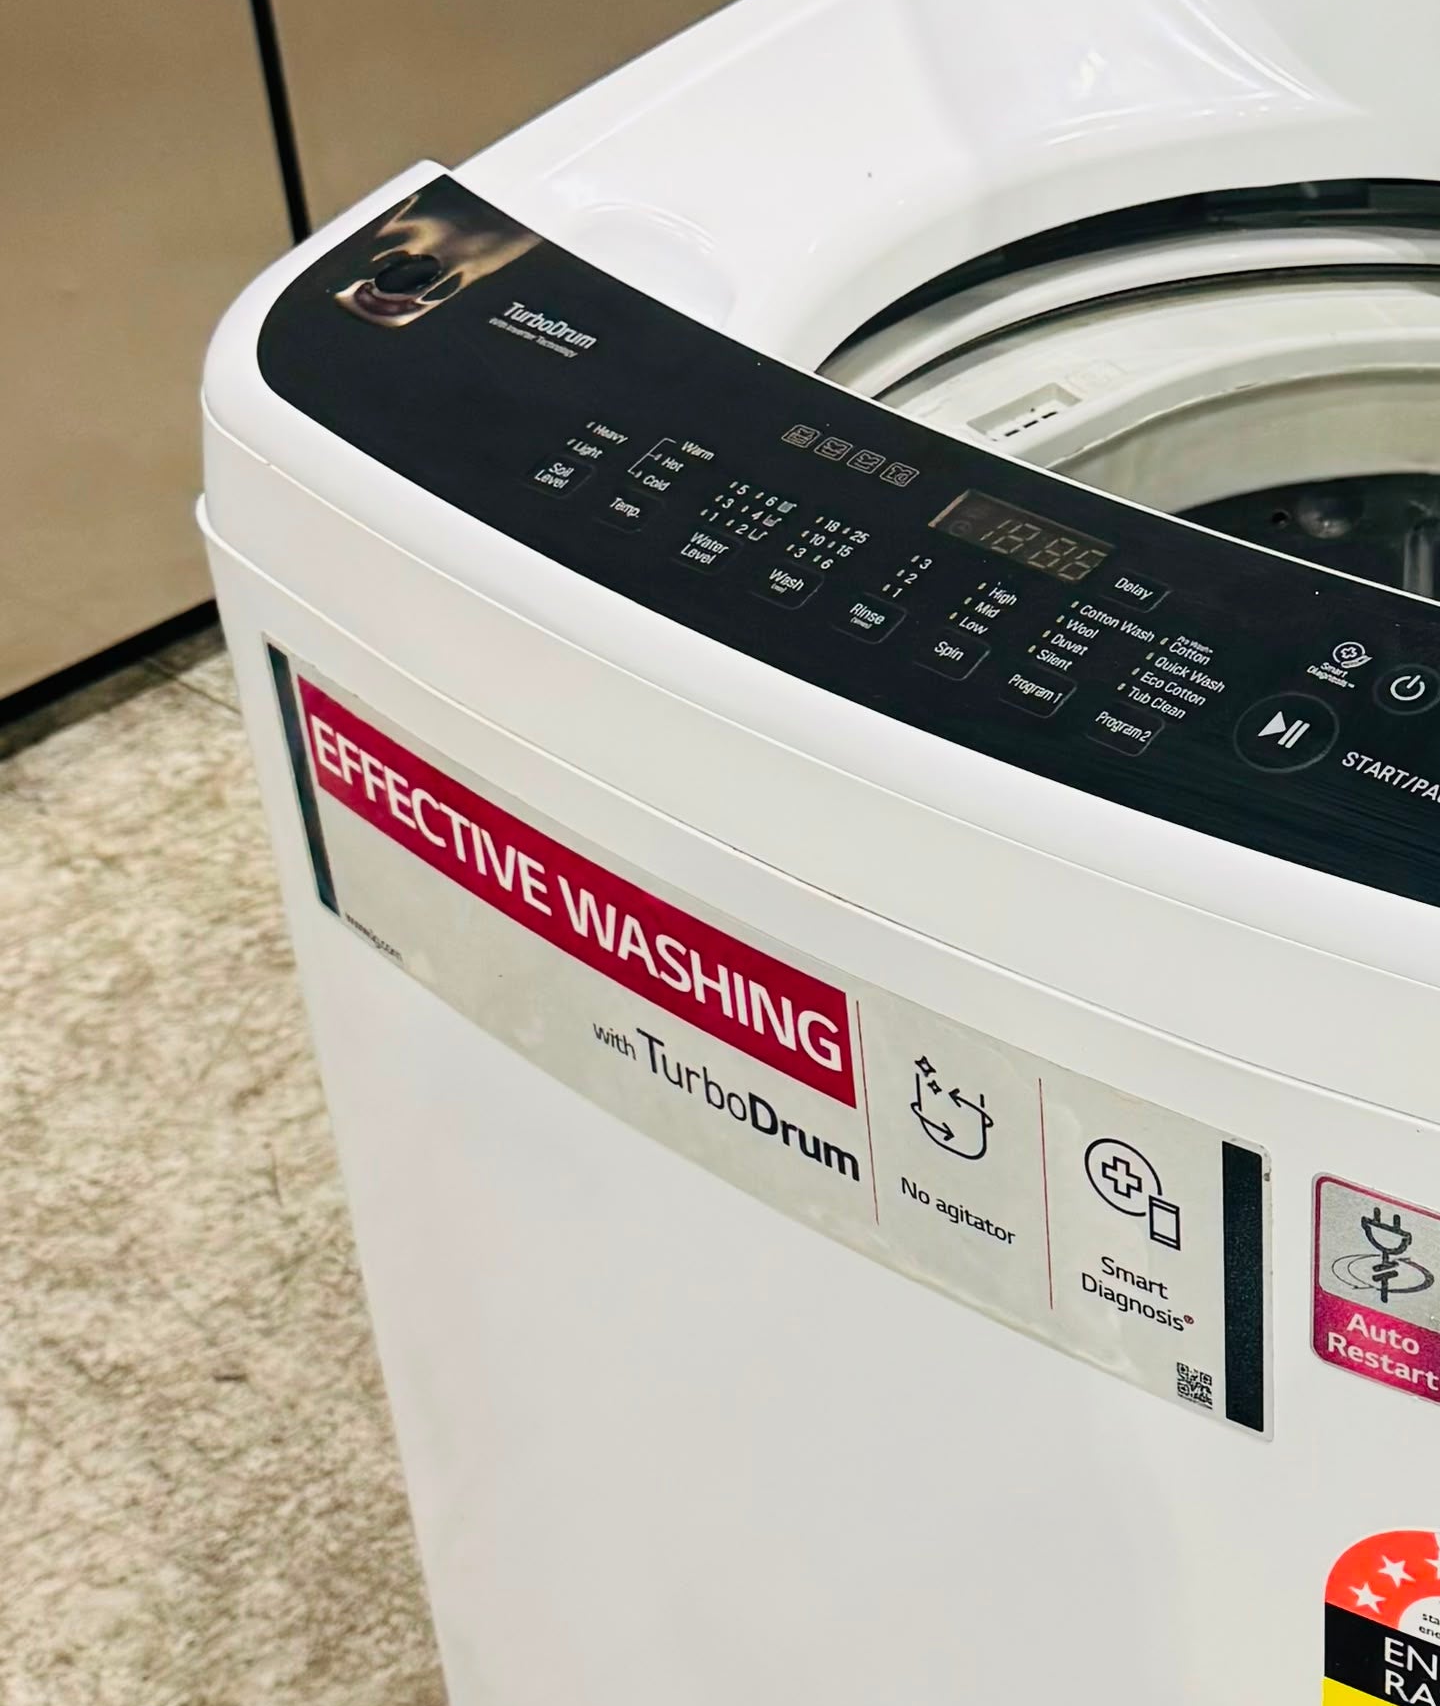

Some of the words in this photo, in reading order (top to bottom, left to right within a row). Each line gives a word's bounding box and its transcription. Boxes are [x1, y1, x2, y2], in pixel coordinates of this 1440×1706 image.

[503, 301, 598, 349] TurboDrum
[592, 424, 628, 444] Heavy
[572, 440, 603, 459] Light
[680, 441, 715, 461] Warm
[548, 462, 575, 478] Soil
[661, 457, 685, 472] Hot
[534, 469, 569, 489] Level
[642, 474, 671, 492] Cold
[736, 484, 750, 495] 5
[765, 496, 778, 507] 6
[609, 497, 641, 518] Temp.
[721, 498, 735, 509] 3
[751, 510, 764, 521] 4
[708, 512, 719, 522] 1
[735, 524, 749, 535] 2
[824, 519, 841, 533] 18
[849, 530, 870, 544] 25
[680, 543, 717, 565] Level
[689, 532, 729, 555] Water
[809, 533, 826, 546] 10
[836, 544, 854, 558] 15
[793, 547, 807, 558] 3
[820, 558, 834, 570] 6
[919, 558, 933, 570] 3
[769, 568, 805, 592] Wash
[904, 573, 918, 584] 2
[1114, 577, 1154, 601] Delay
[892, 587, 903, 598] 1
[989, 585, 1018, 607] High
[849, 603, 886, 625] Rinse
[974, 601, 1000, 619] Mid
[959, 616, 988, 636] Low
[1066, 619, 1100, 640] Wool
[1079, 604, 1120, 629] Cotton
[1120, 620, 1156, 644] Wash
[934, 641, 964, 662] Spin
[1050, 633, 1089, 657] Duvet
[1168, 641, 1211, 666] Cotton
[1036, 648, 1073, 672] Silent
[1320, 662, 1348, 678] Smart
[1154, 656, 1191, 679] Quick
[1190, 670, 1226, 694] Wash
[1008, 674, 1055, 702] Program
[1140, 671, 1164, 689] Eco
[1164, 681, 1207, 707] Cotton
[1128, 686, 1151, 705] Tub
[1150, 696, 1187, 720] Clean
[1095, 711, 1144, 740] Program
[308, 715, 553, 917] EFFECTIVE
[556, 873, 844, 1073] WASHING
[592, 1022, 638, 1061] with
[635, 1027, 860, 1182] TurboDrum
[900, 1176, 931, 1206] No
[935, 1197, 1017, 1245] agitator
[1100, 1255, 1170, 1301] Smart
[1346, 1311, 1421, 1356] Auto
[1326, 1332, 1440, 1392] Restart
